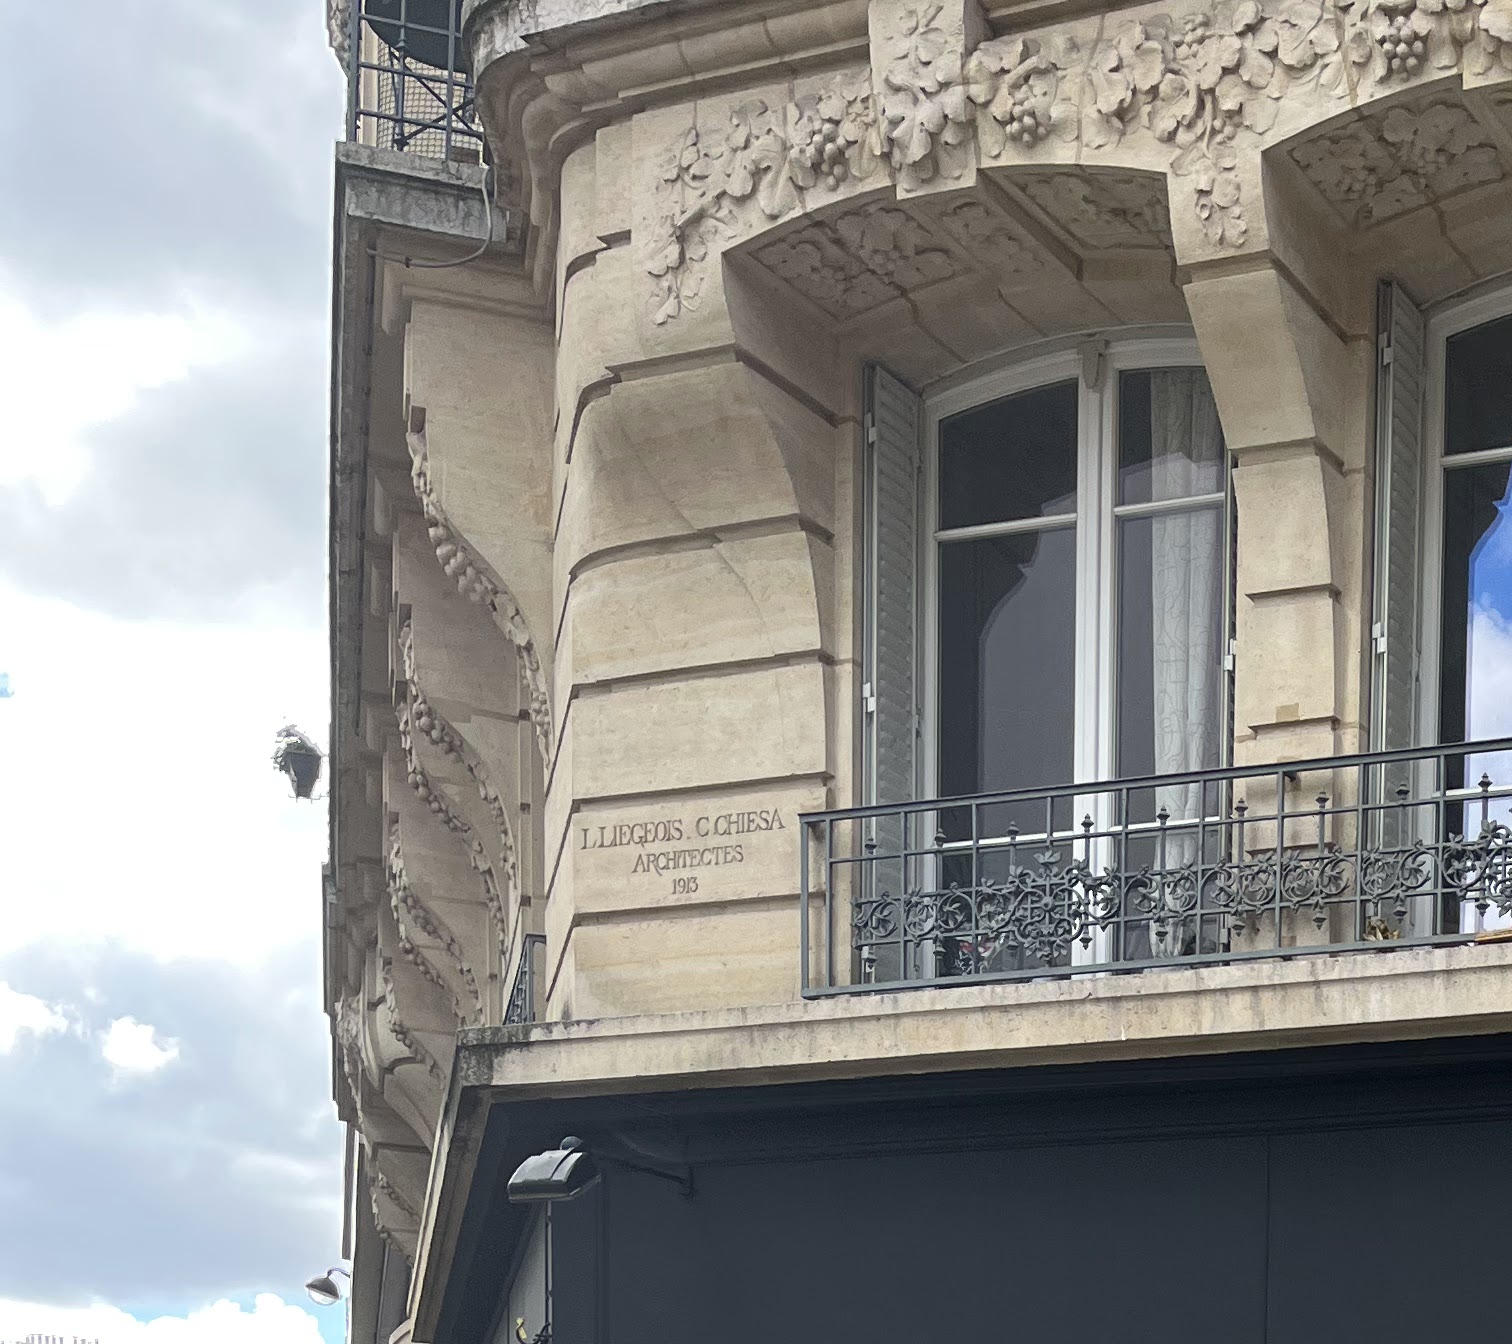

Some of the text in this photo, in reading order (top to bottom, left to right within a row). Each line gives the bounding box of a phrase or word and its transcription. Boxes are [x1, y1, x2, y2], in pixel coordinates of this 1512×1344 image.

[713, 808, 786, 836] CHIESA
[631, 844, 744, 876] ARCHITECTES
[671, 876, 699, 895] 1913
